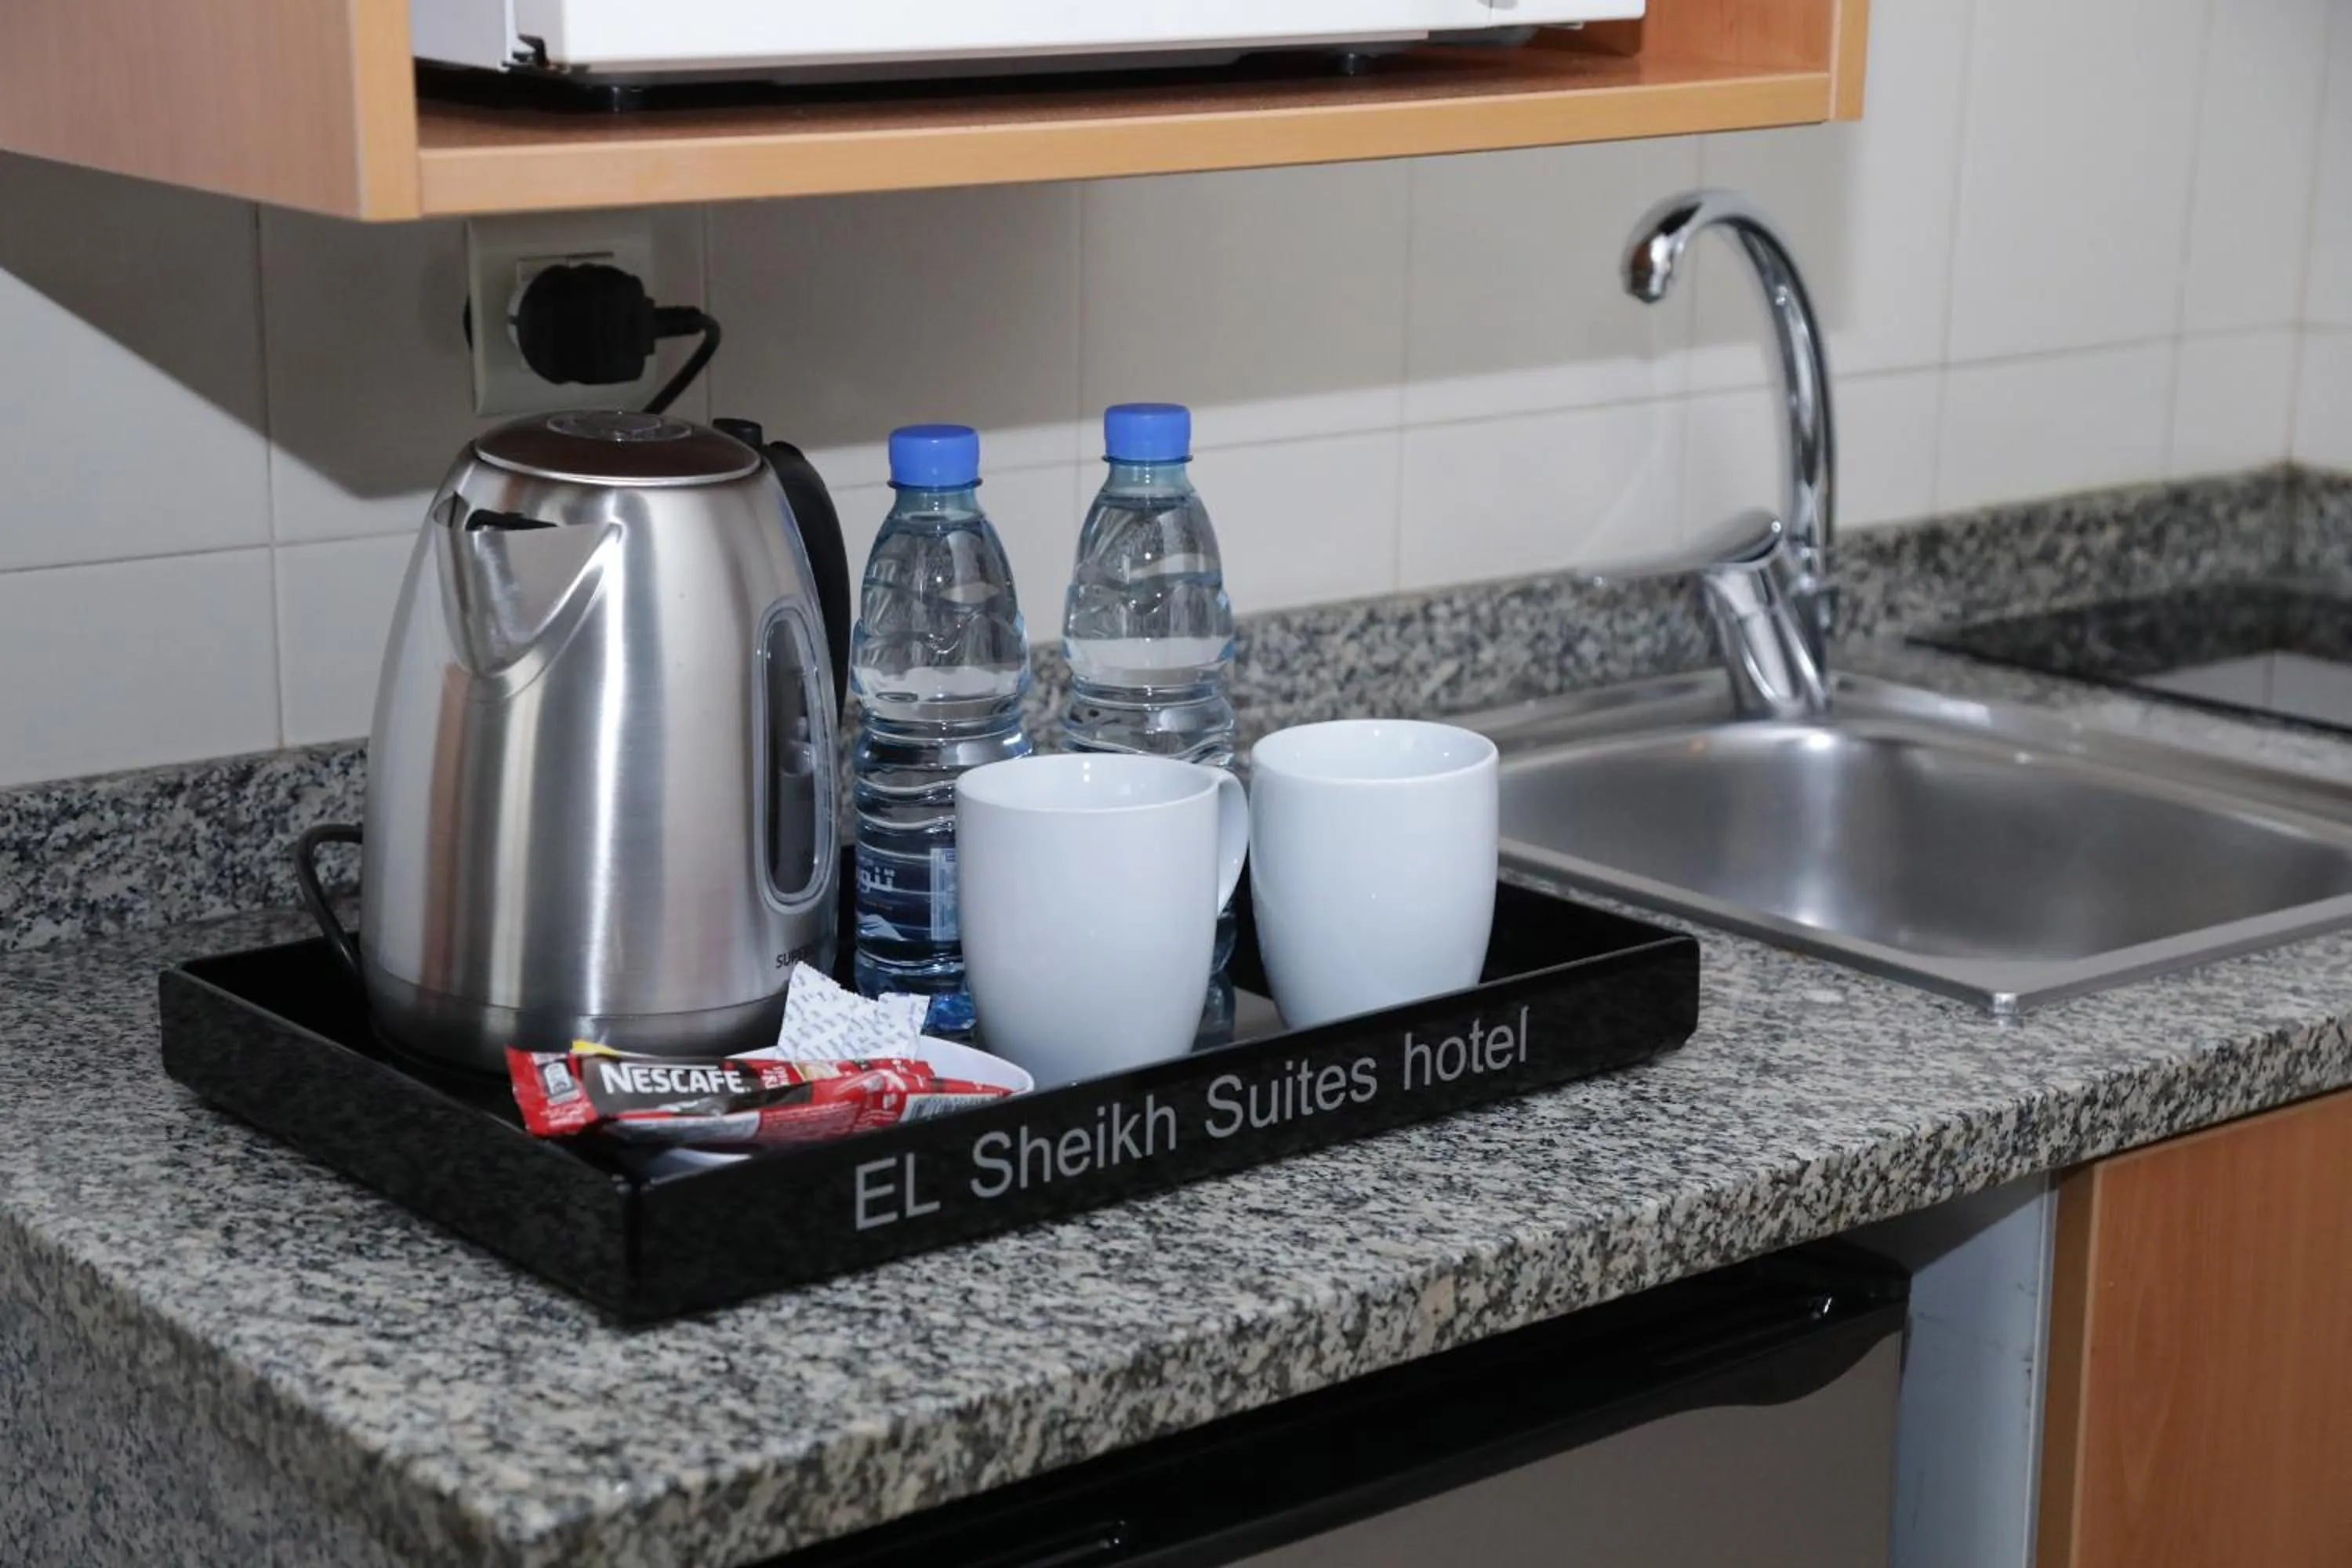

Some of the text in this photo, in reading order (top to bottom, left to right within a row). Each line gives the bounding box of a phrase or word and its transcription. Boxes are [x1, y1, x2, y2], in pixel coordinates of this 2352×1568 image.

[855, 1006, 1528, 1229] EL Sheikh Suites hotel
